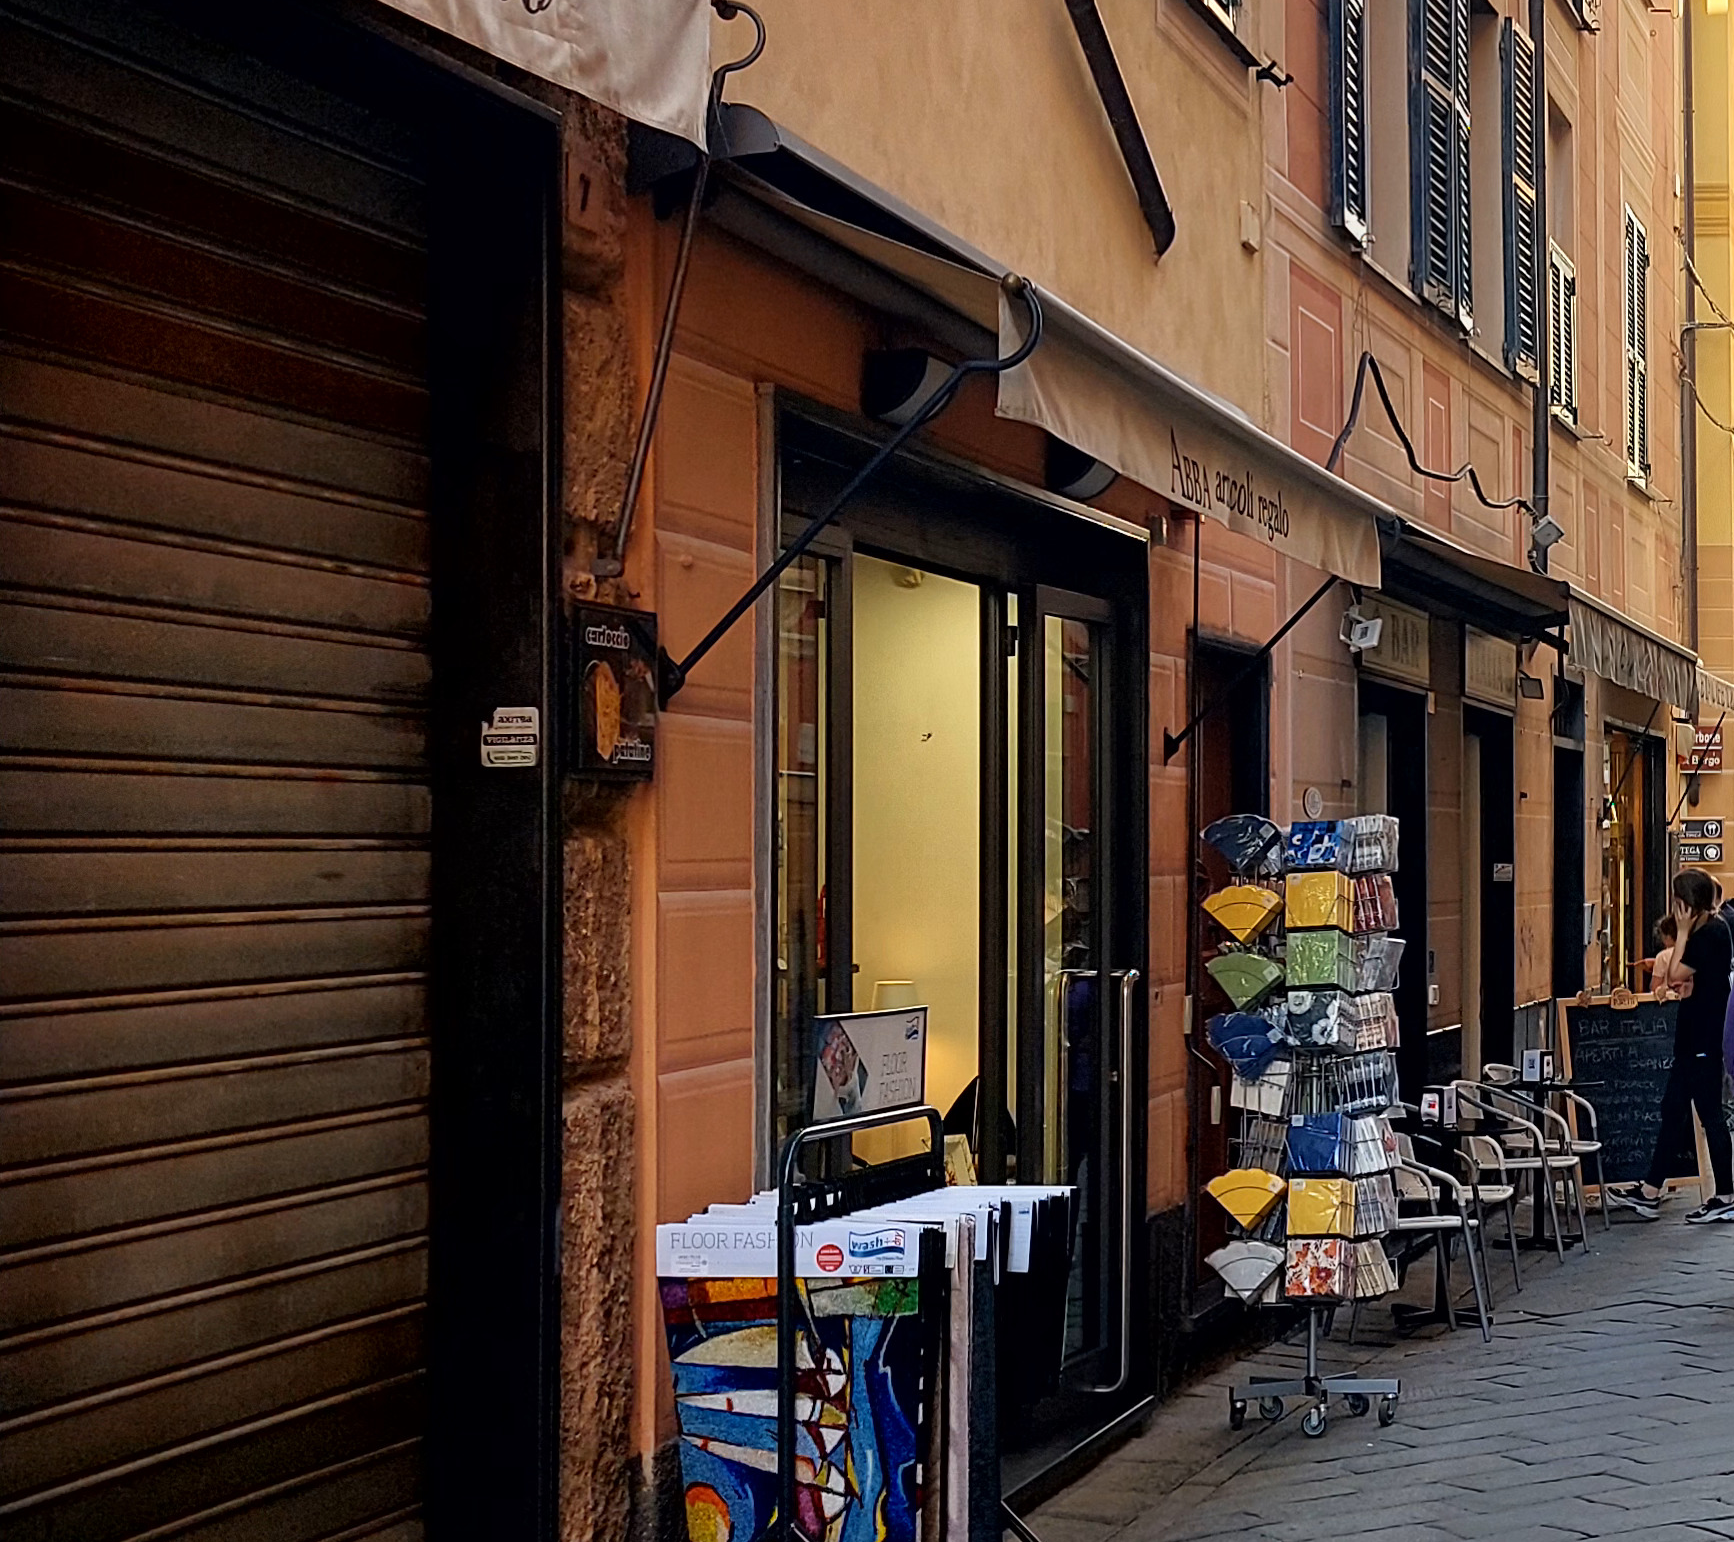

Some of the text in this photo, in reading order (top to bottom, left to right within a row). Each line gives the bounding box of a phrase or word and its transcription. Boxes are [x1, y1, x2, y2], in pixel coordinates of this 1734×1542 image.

[1171, 425, 1212, 510] ABBA
[1258, 490, 1289, 541] regalo
[1578, 1017, 1668, 1036] BAR ITALIA
[671, 1231, 813, 1250] FLOOR FASHN
